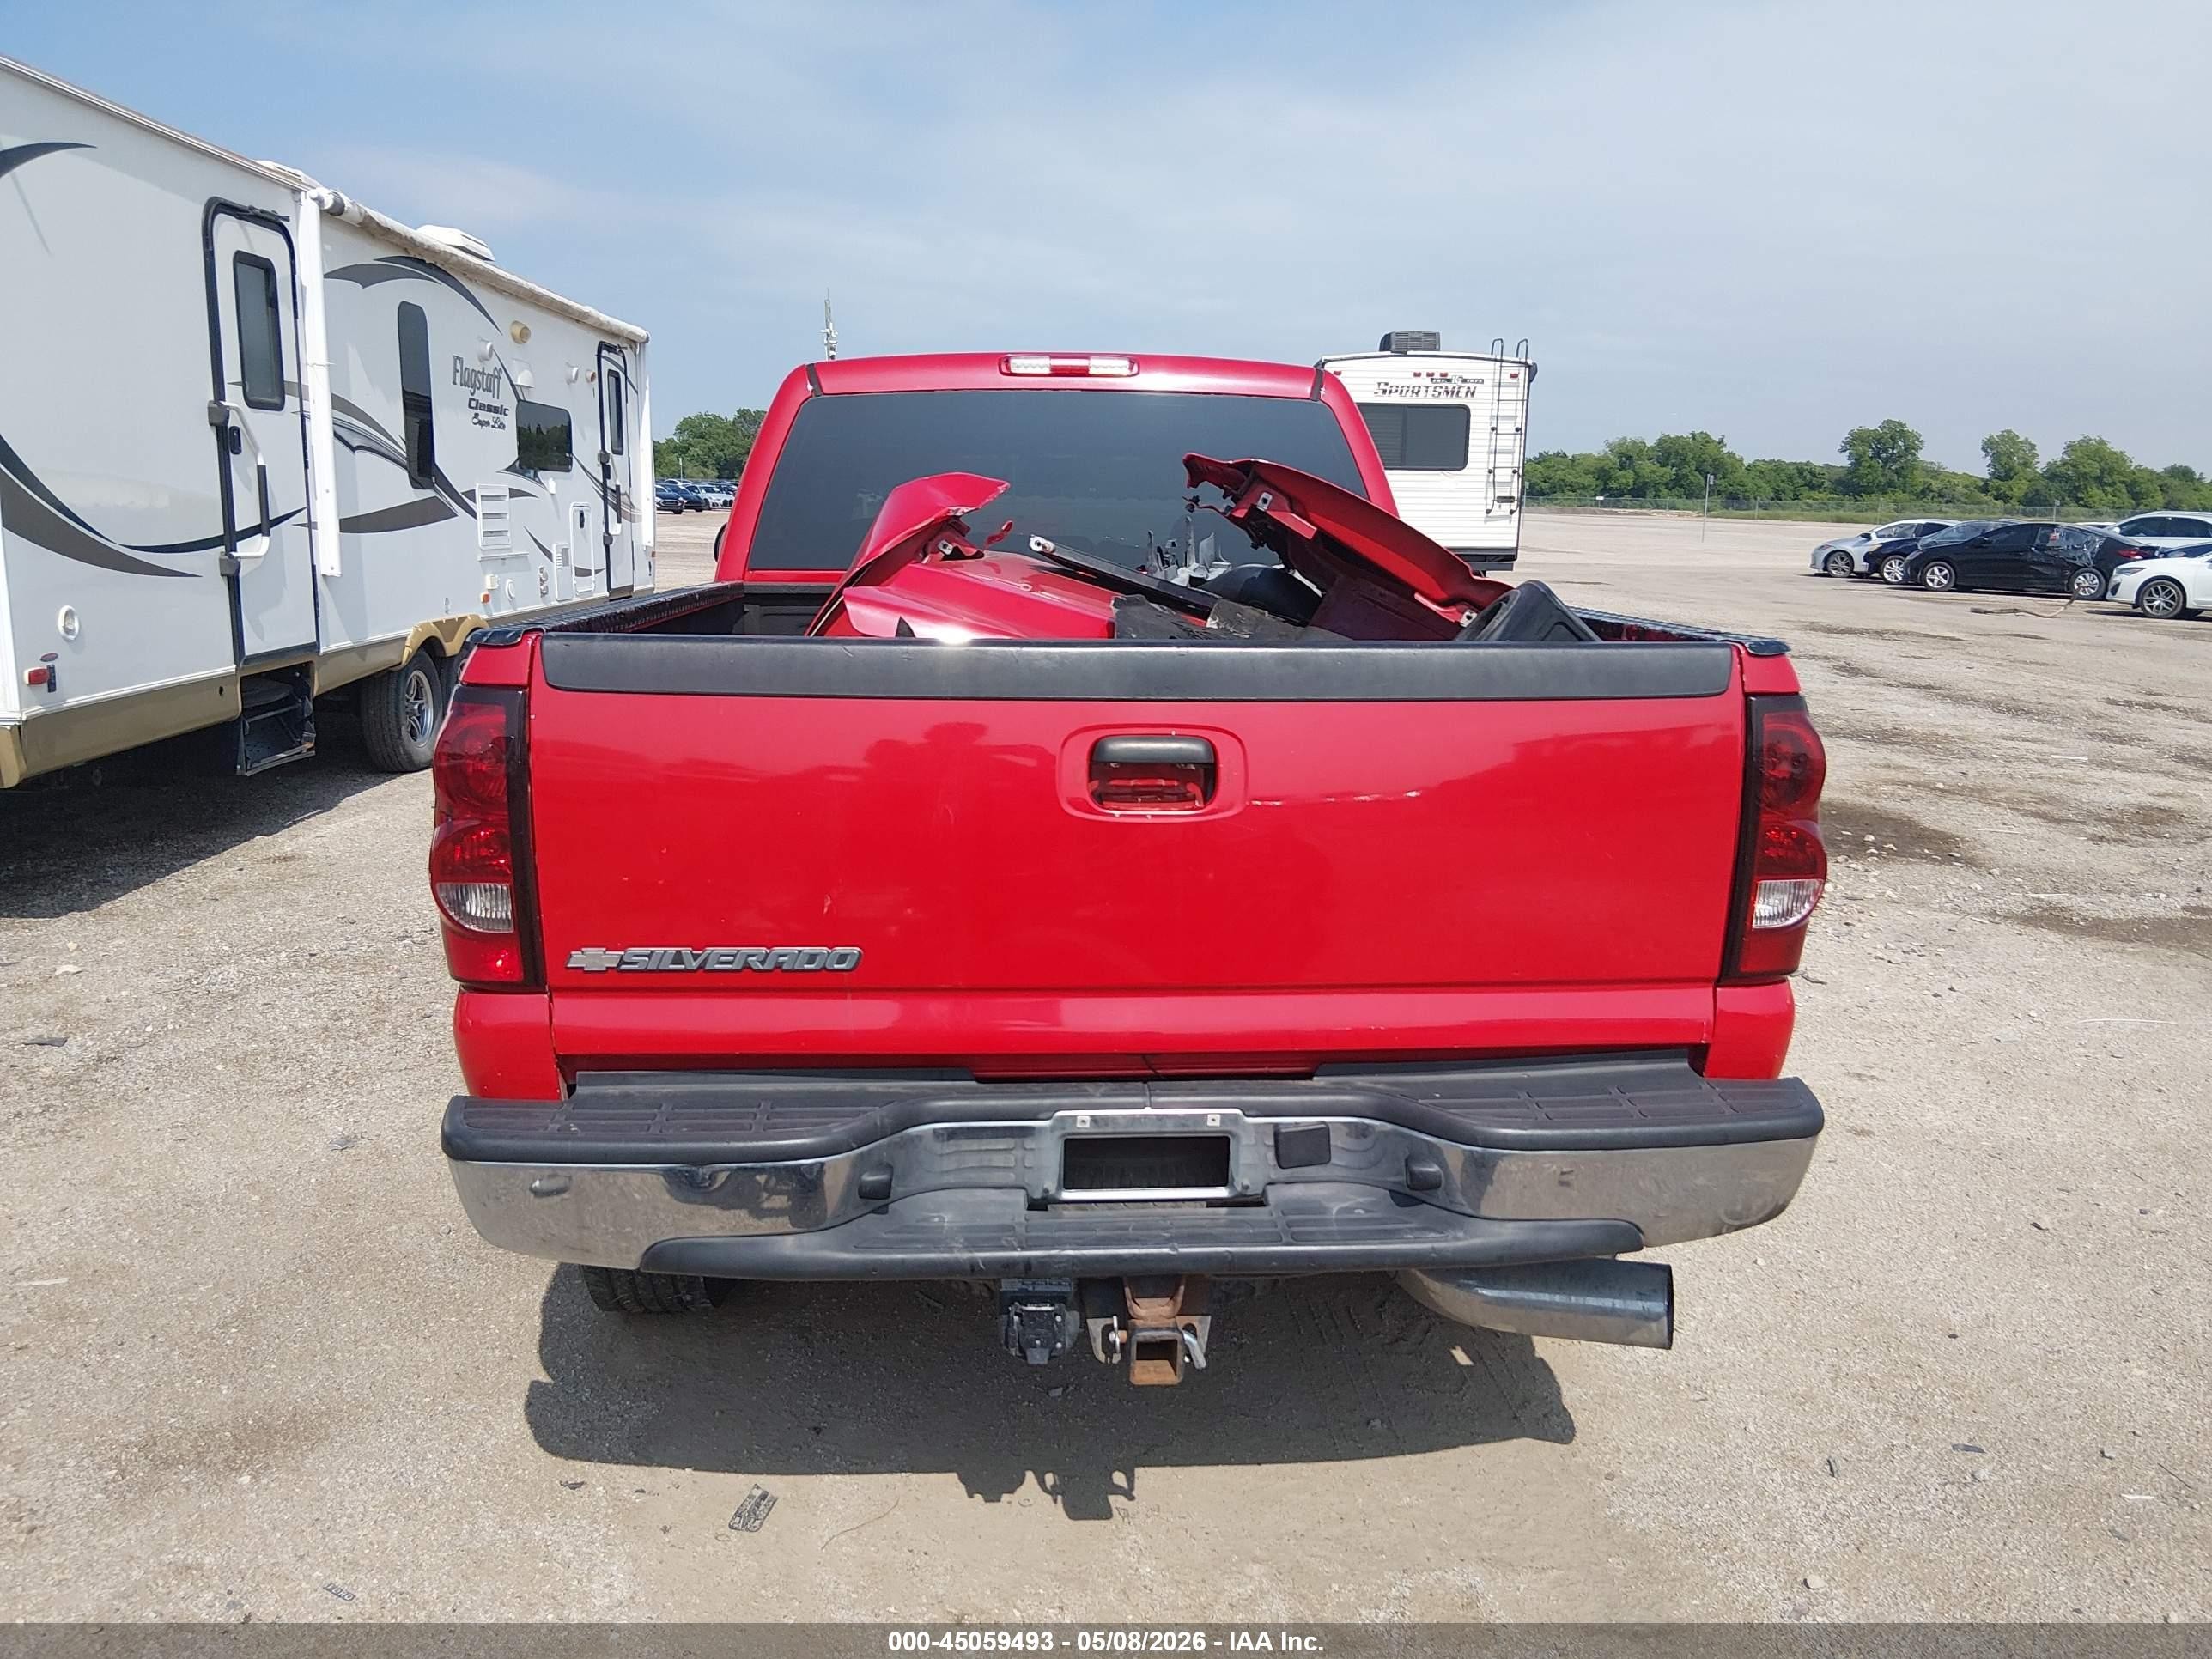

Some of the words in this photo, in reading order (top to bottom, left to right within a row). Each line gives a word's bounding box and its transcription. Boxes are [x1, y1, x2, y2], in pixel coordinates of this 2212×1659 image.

[453, 355, 502, 400] Flagstaff
[1374, 382, 1477, 398] SPORTSMEN
[468, 398, 510, 416] Classic
[617, 946, 862, 971] SILVERADO
